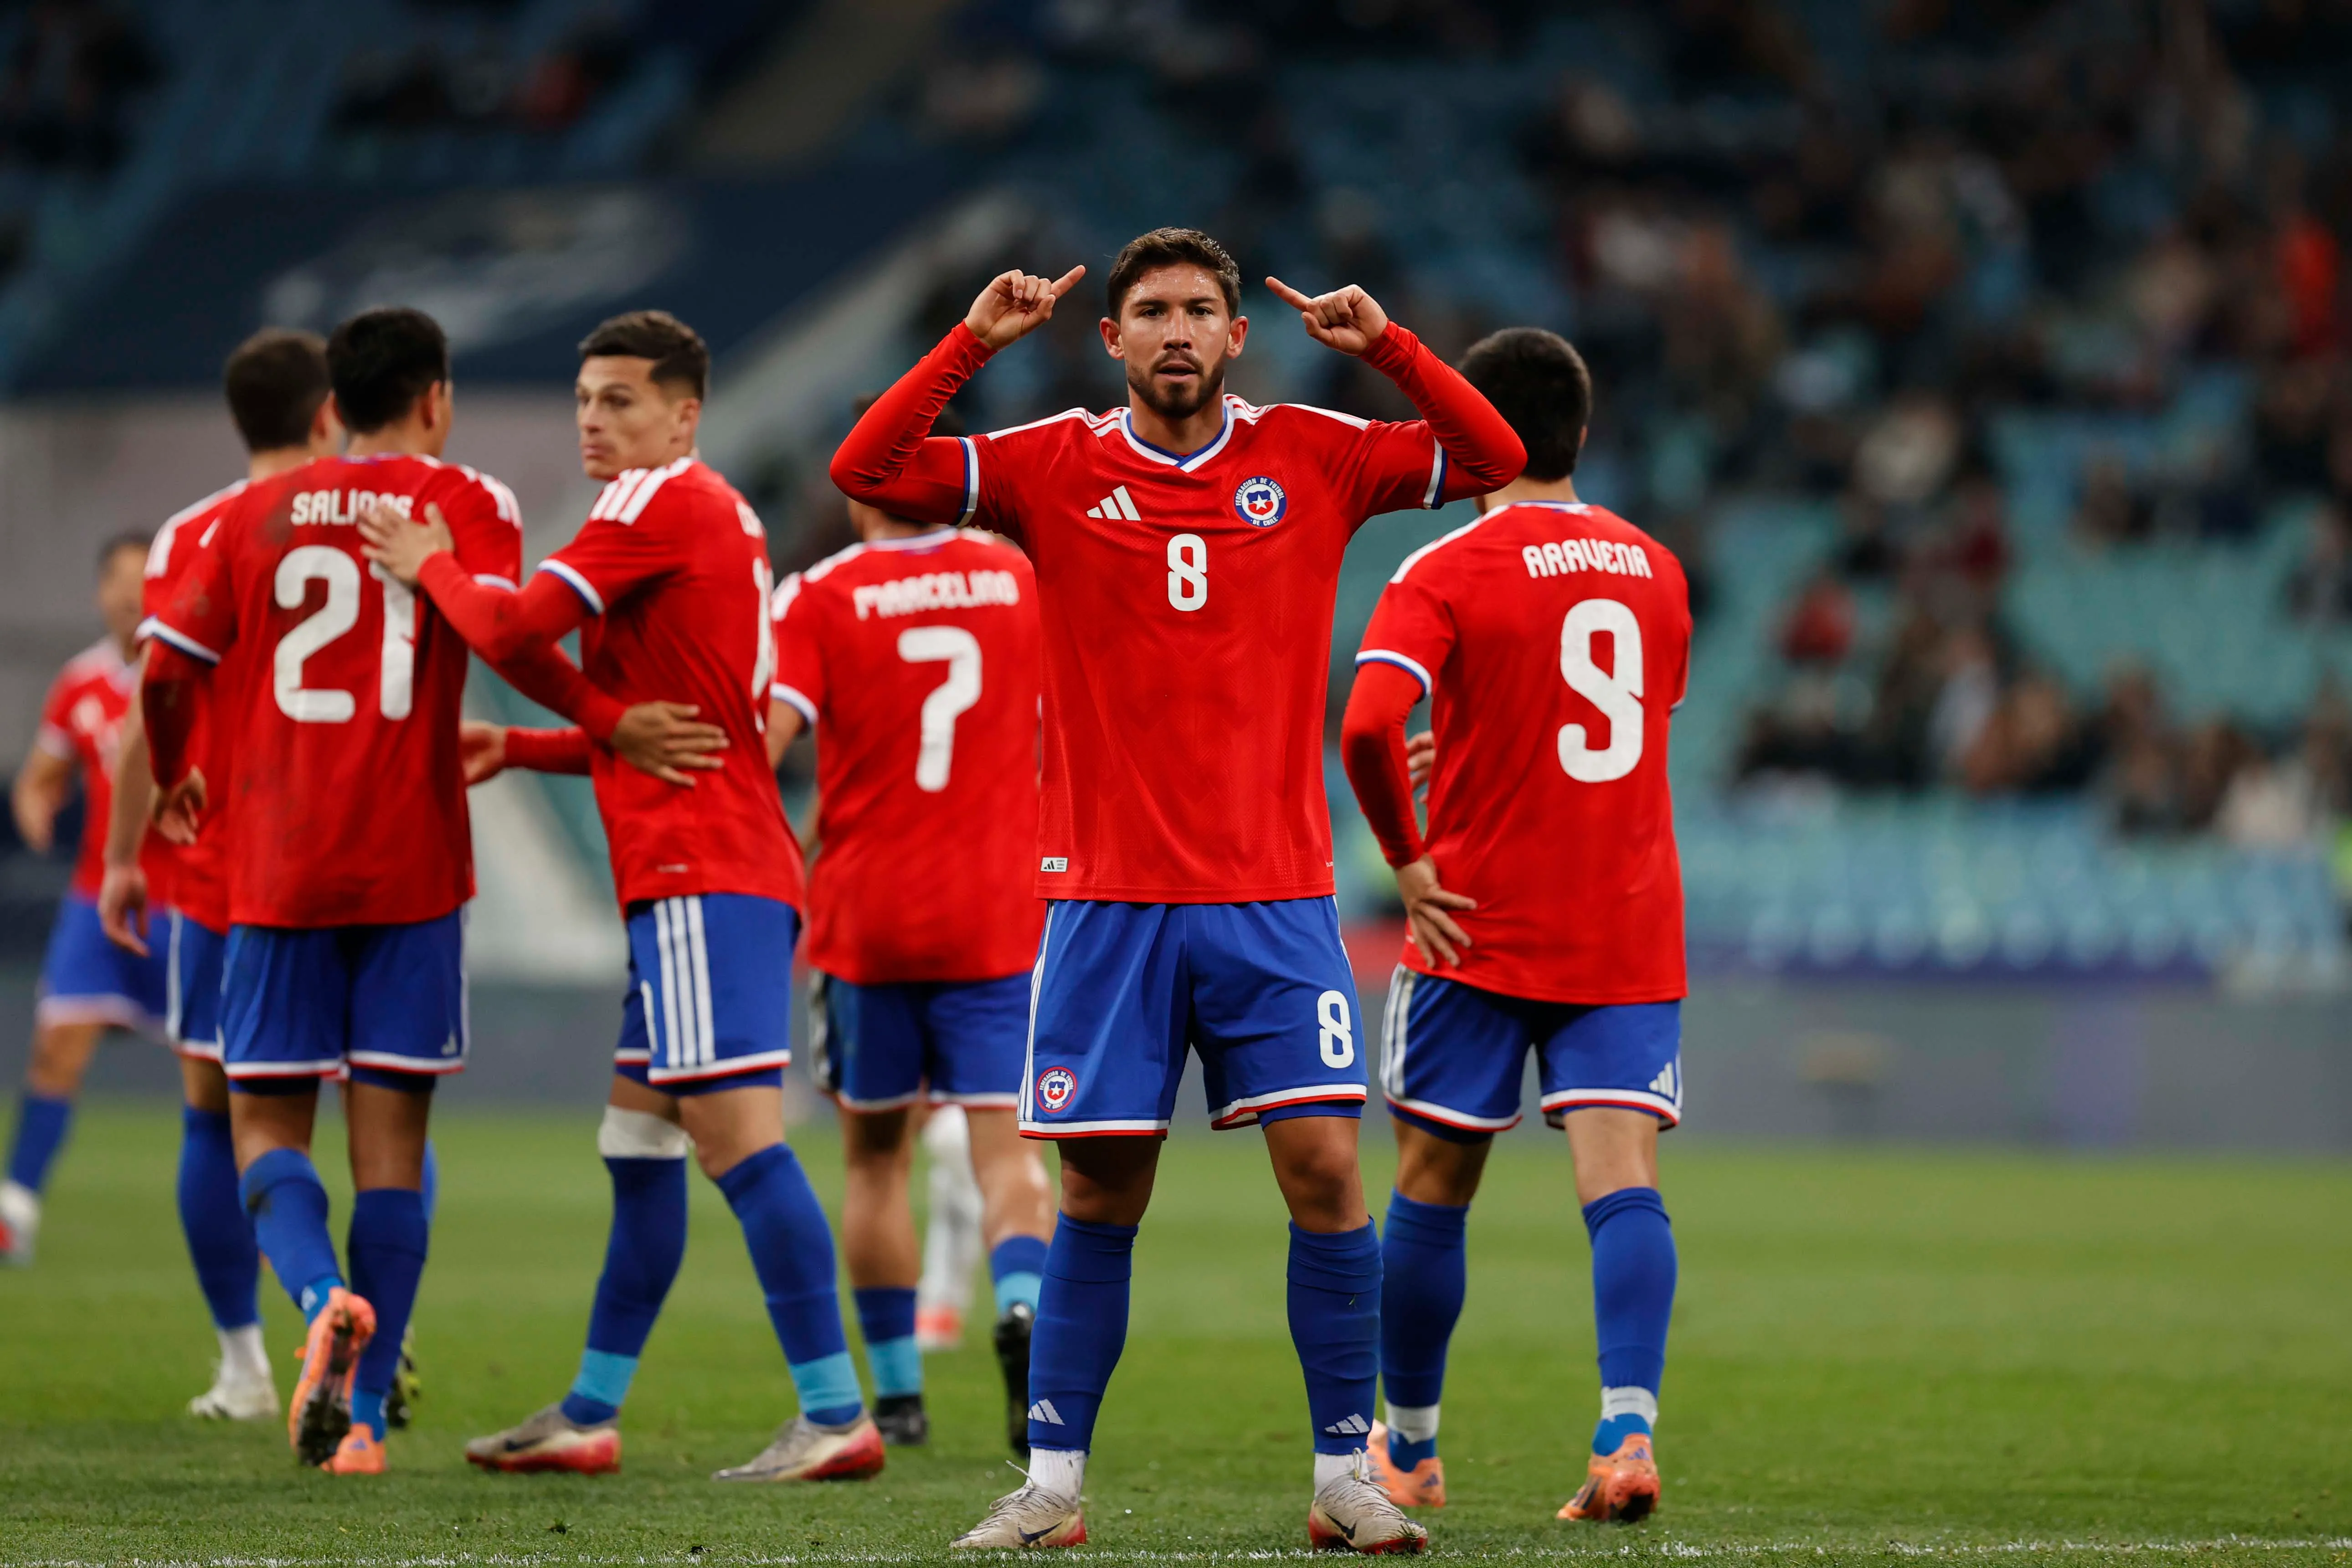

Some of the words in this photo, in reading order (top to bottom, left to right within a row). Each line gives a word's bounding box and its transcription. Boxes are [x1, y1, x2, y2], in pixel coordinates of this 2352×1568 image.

[1235, 478, 1256, 506] FEDERACION
[1269, 481, 1285, 499] FUTBOL
[1263, 516, 1278, 526] CHILE
[853, 570, 1019, 620] MARCELINO
[1167, 533, 1208, 612] 8
[1522, 538, 1653, 579] ARAVENA
[274, 545, 414, 722] 21
[898, 626, 982, 792] 7
[1557, 598, 1644, 783] 9
[1317, 990, 1355, 1069] 8
